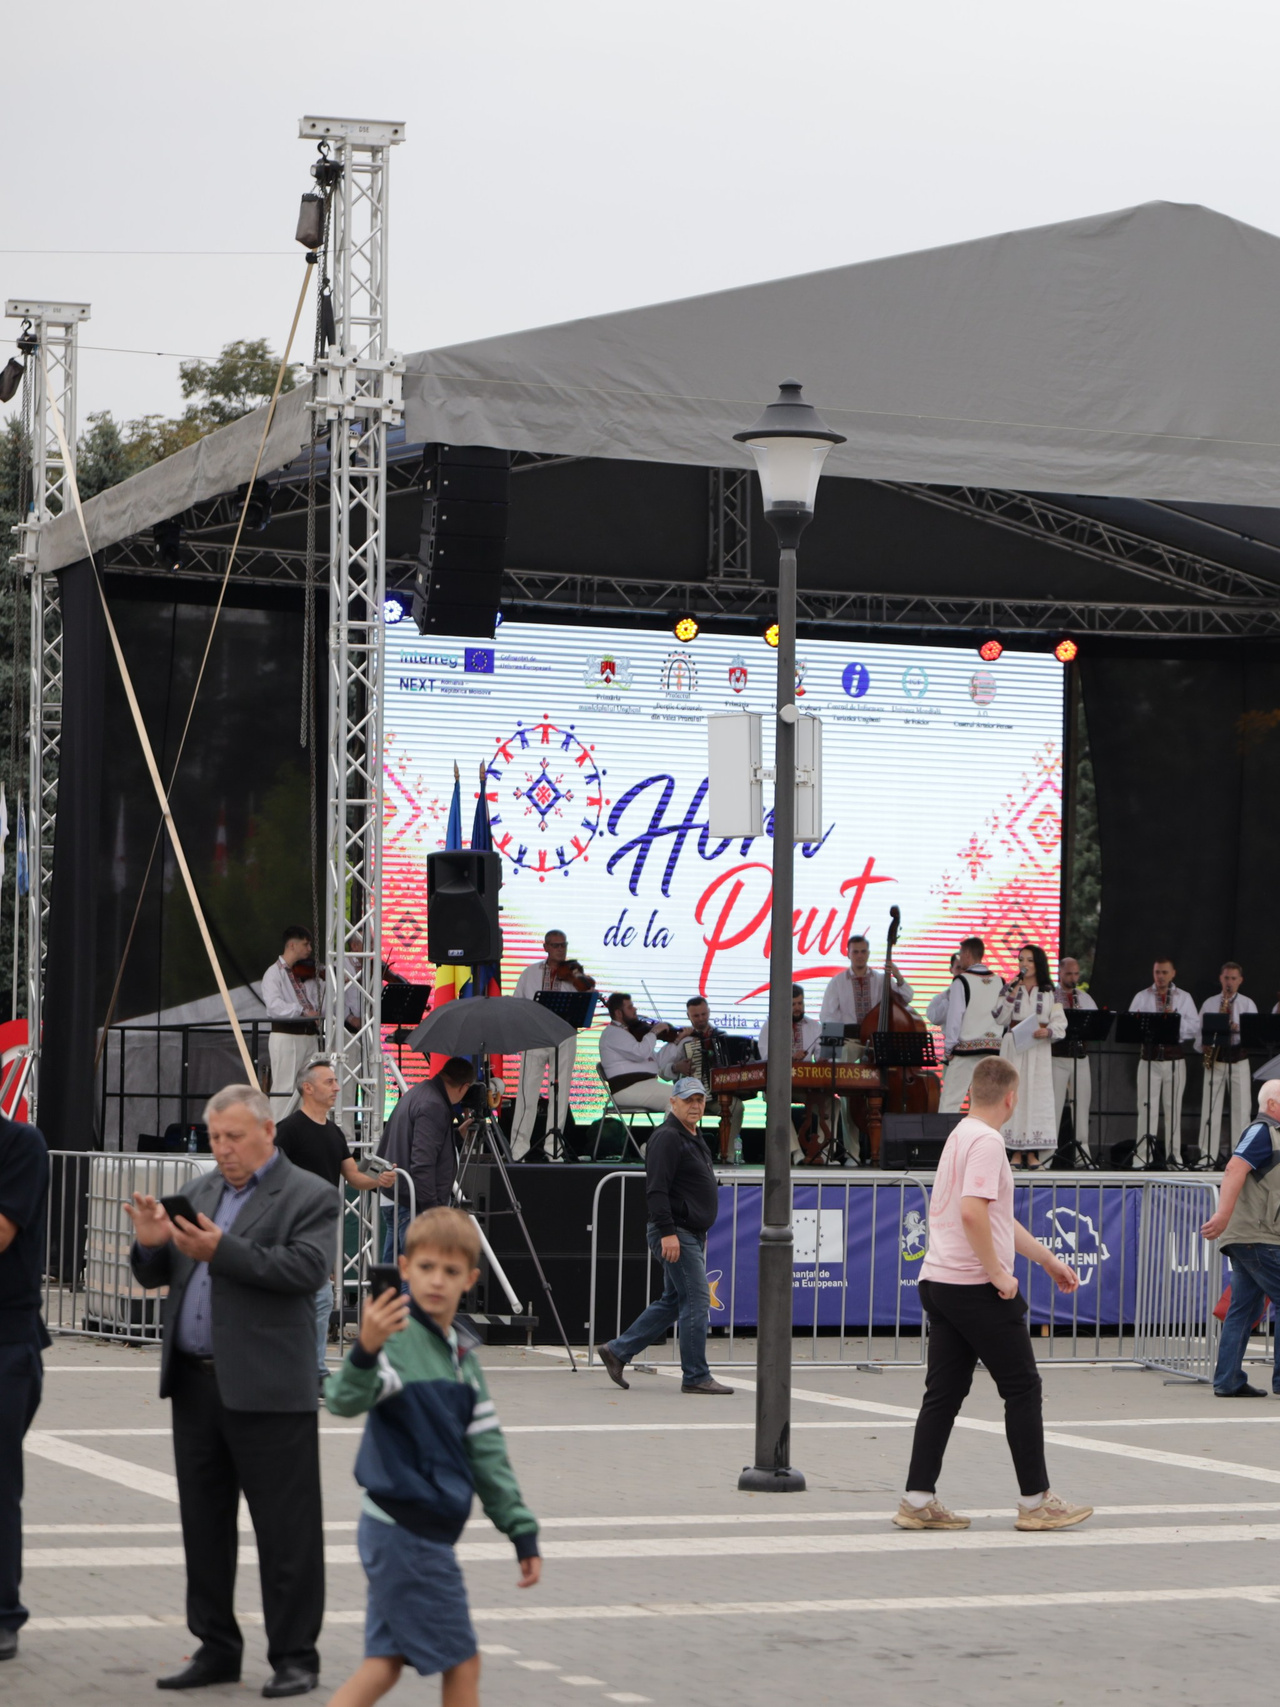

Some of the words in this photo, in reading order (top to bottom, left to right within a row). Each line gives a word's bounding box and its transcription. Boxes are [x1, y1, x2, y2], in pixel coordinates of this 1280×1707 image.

[400, 677, 436, 692] NEXT
[603, 908, 637, 947] de
[643, 909, 674, 948] la
